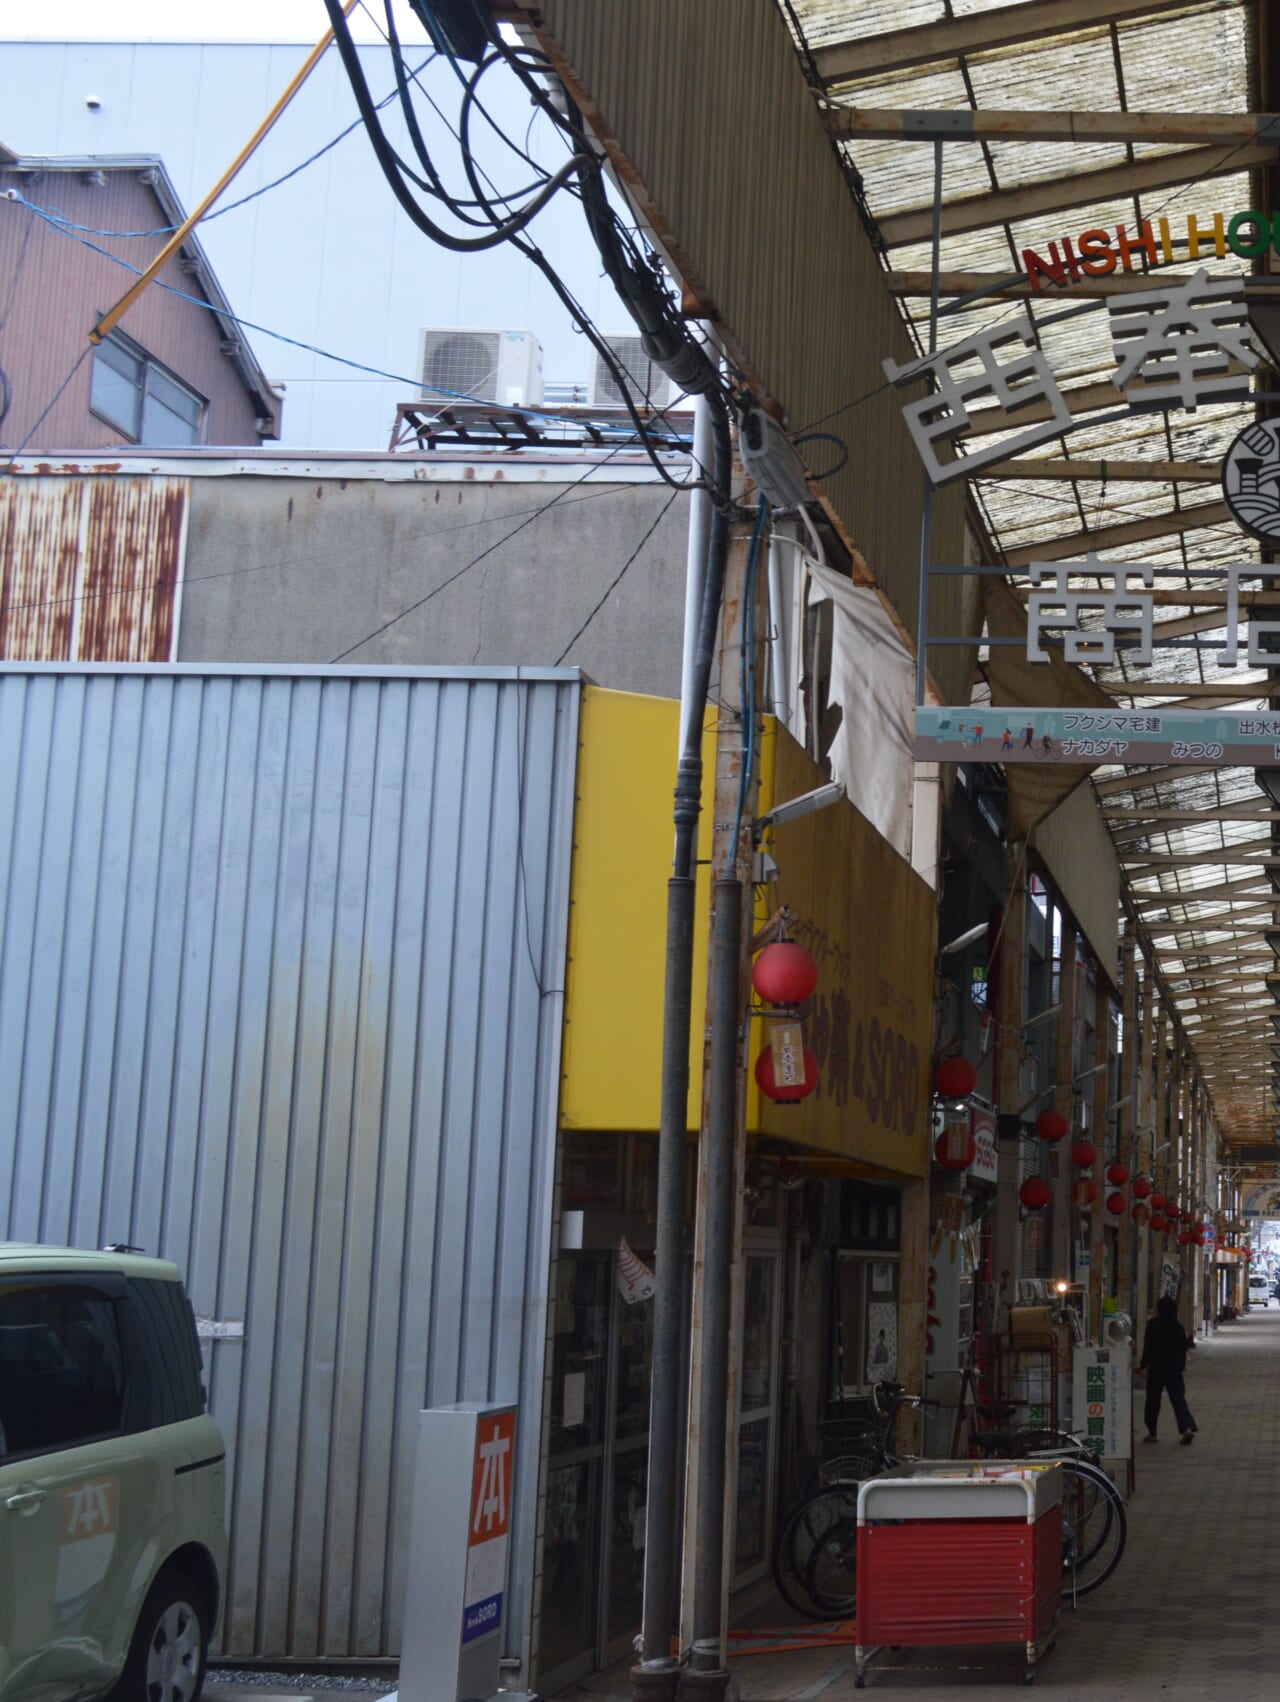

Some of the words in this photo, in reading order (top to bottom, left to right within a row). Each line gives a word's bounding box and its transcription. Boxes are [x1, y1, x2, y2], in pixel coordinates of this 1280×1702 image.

[1022, 215, 1174, 292] NISHI
[1061, 739, 1128, 756] ナカダヤ
[1172, 741, 1222, 759] みつの
[1063, 714, 1161, 733] フクシマ宅建
[1087, 1366, 1105, 1456] 映画の冒険
[473, 1425, 512, 1535] 本
